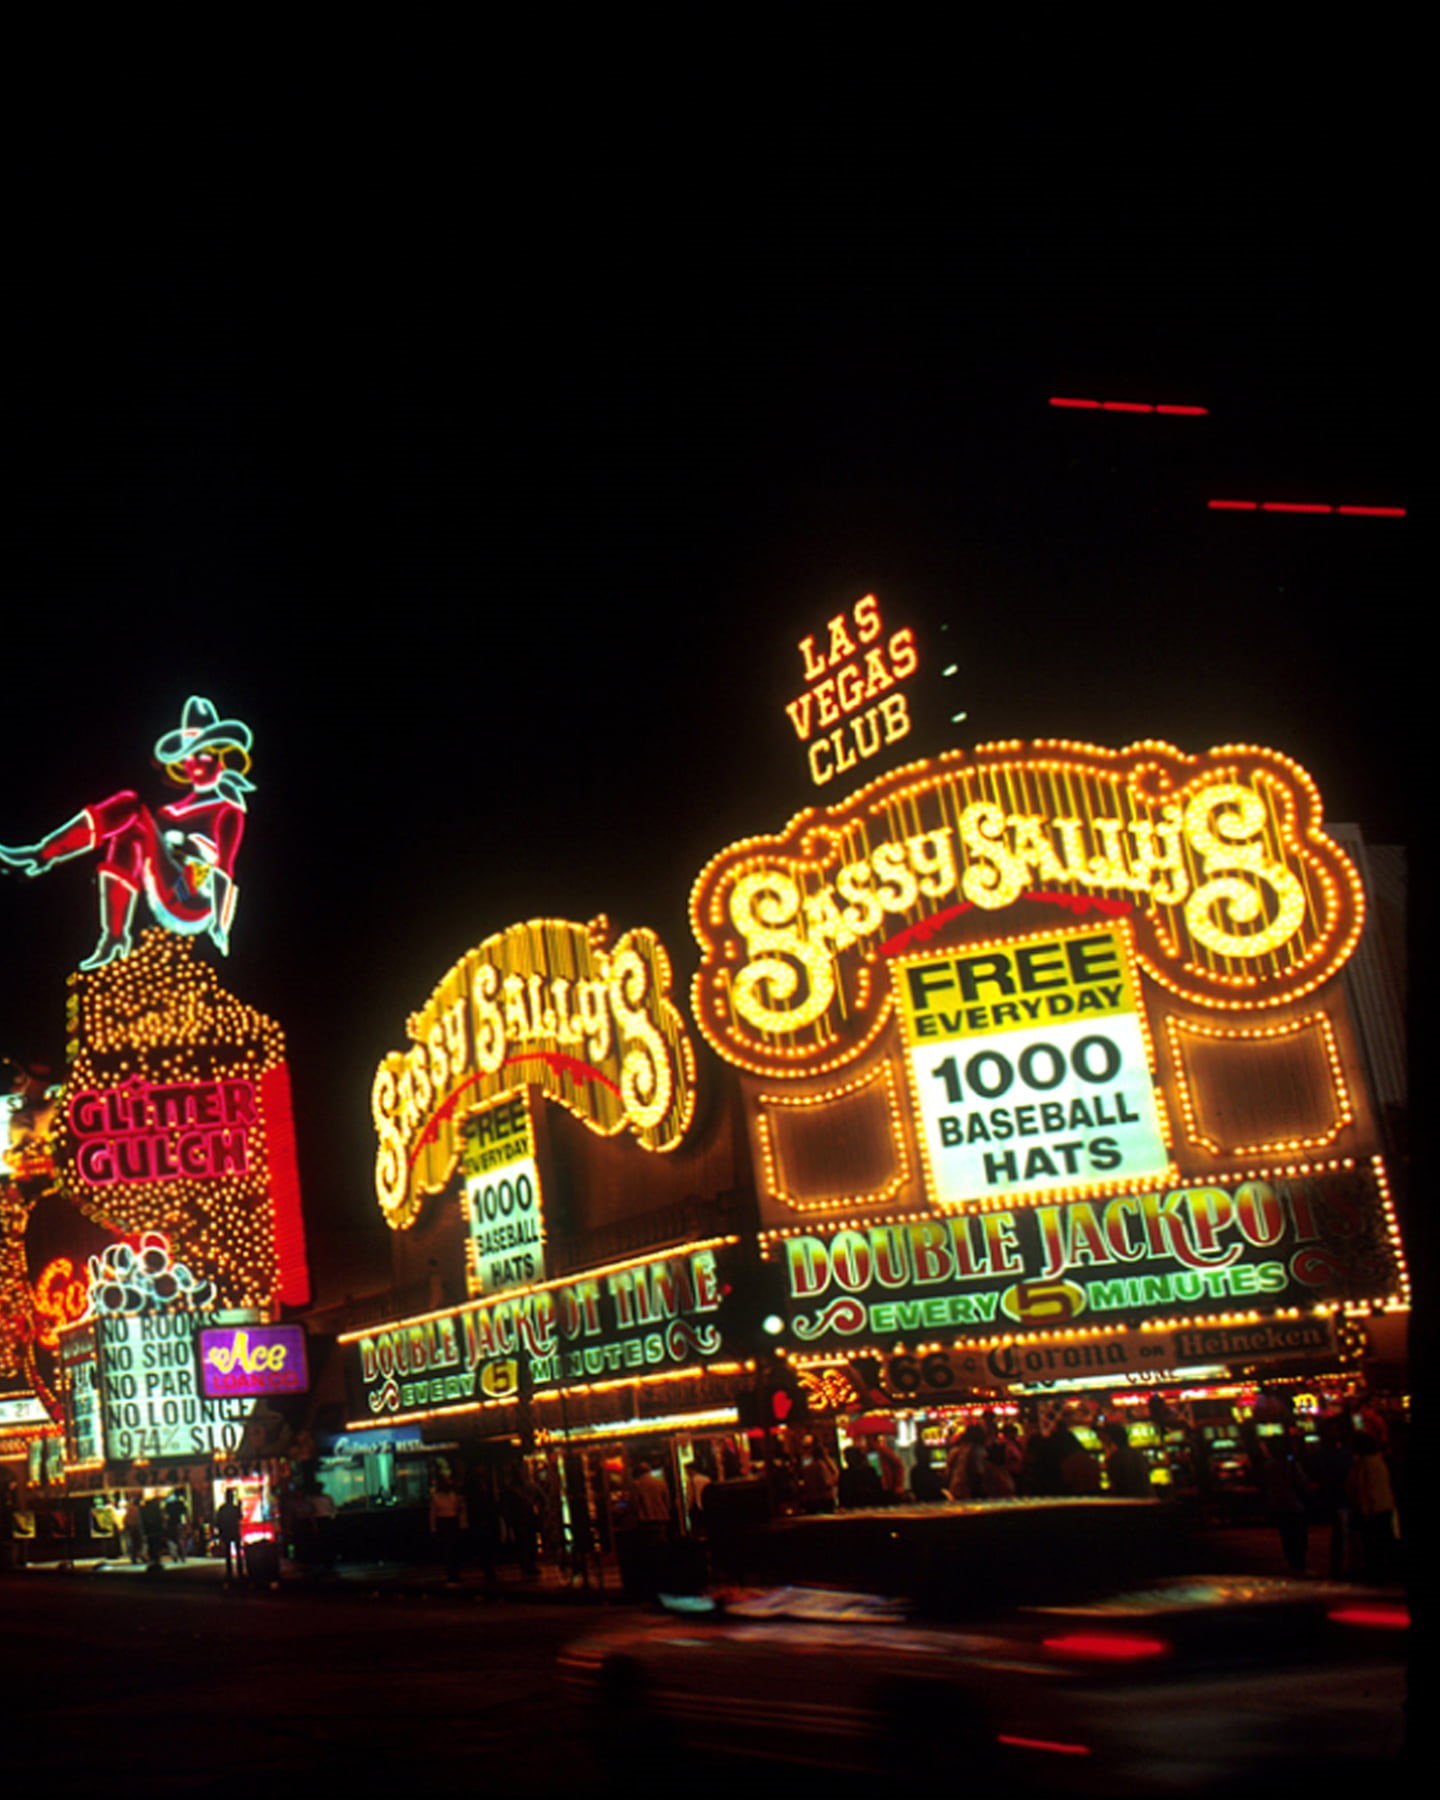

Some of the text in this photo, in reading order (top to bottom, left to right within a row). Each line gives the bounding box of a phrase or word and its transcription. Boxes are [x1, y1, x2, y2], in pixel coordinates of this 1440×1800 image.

[798, 594, 881, 681] LAS
[785, 629, 918, 740] VEGAS
[808, 693, 910, 785] CLUB
[729, 828, 953, 1033] SASSY
[906, 932, 1124, 1010] FREE
[915, 985, 1125, 1038] EVERYDAY
[931, 1035, 1122, 1104] 1000
[372, 998, 466, 1208] SASSY
[464, 1095, 526, 1148] FREE
[939, 1092, 1139, 1148] BASEBALL
[78, 1129, 250, 1185] GULCH
[464, 1136, 528, 1174] EVERYDAY
[982, 1137, 1123, 1186] HATS
[473, 1173, 533, 1224] 1000
[476, 1217, 539, 1257] BASEBALL
[785, 1211, 1026, 1298] DOUBLE
[490, 1253, 535, 1287] HATS
[361, 1312, 460, 1384] DOUBLE
[609, 1248, 720, 1330] TIME
[870, 1263, 1289, 1334] EVERY 5 MINUTES
[101, 1316, 129, 1343] NO
[209, 1332, 287, 1374] Ace
[104, 1345, 133, 1371] NO
[213, 1374, 264, 1391] LOAN
[402, 1373, 476, 1406] EVERY
[529, 1333, 665, 1383] MINUTES
[889, 1353, 954, 1390] 66
[987, 1342, 1128, 1379] Corona
[1181, 1326, 1321, 1354] Heineken
[106, 1373, 137, 1400] NO
[108, 1401, 140, 1429] NO
